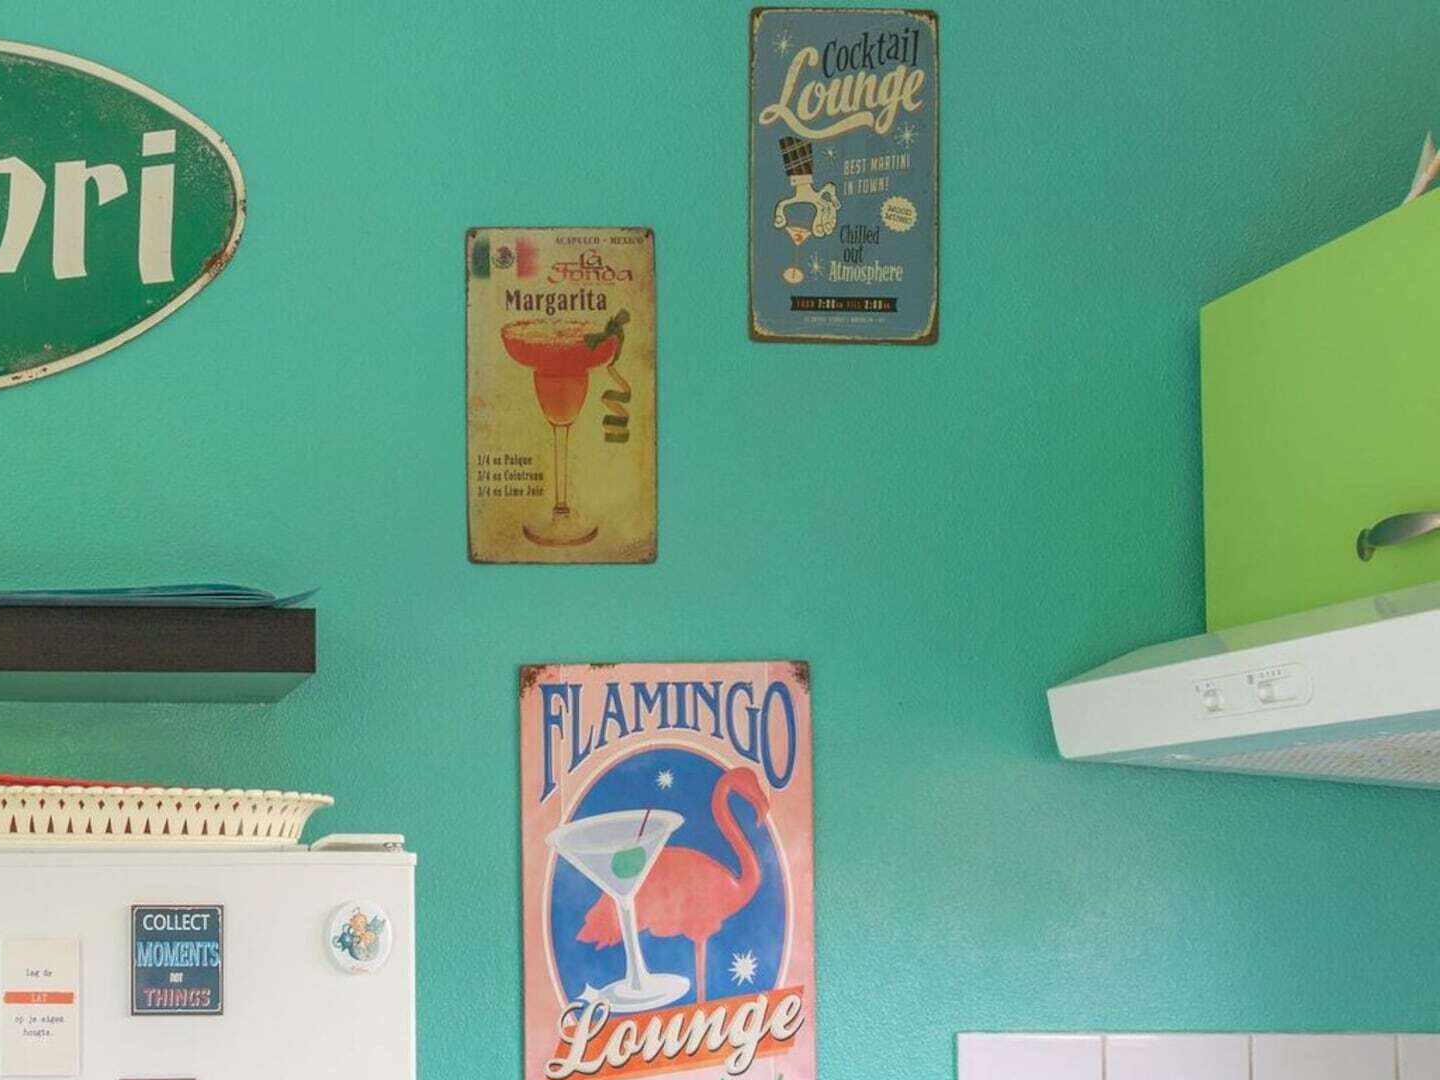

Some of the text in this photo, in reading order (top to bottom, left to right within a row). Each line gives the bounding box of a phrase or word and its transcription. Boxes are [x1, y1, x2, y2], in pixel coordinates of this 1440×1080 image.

[822, 27, 920, 78] Cocktail
[759, 47, 926, 140] Lounge
[843, 154, 910, 176] BEST MARTINI
[843, 177, 889, 195] IN TOWN!
[610, 236, 644, 245] MEXICO
[839, 224, 880, 245] Chilled
[843, 247, 865, 264] out
[547, 260, 634, 284] Fonda
[829, 260, 904, 284] Atmosphere
[506, 288, 607, 316] Margarita
[504, 471, 544, 481] Cointreau
[504, 485, 524, 496] Lime
[538, 680, 796, 804] FLAMINGO
[142, 913, 211, 931] COLLECT
[136, 941, 219, 967] MOMENTS
[144, 988, 211, 1007] THINGS
[14, 1015, 24, 1025] op
